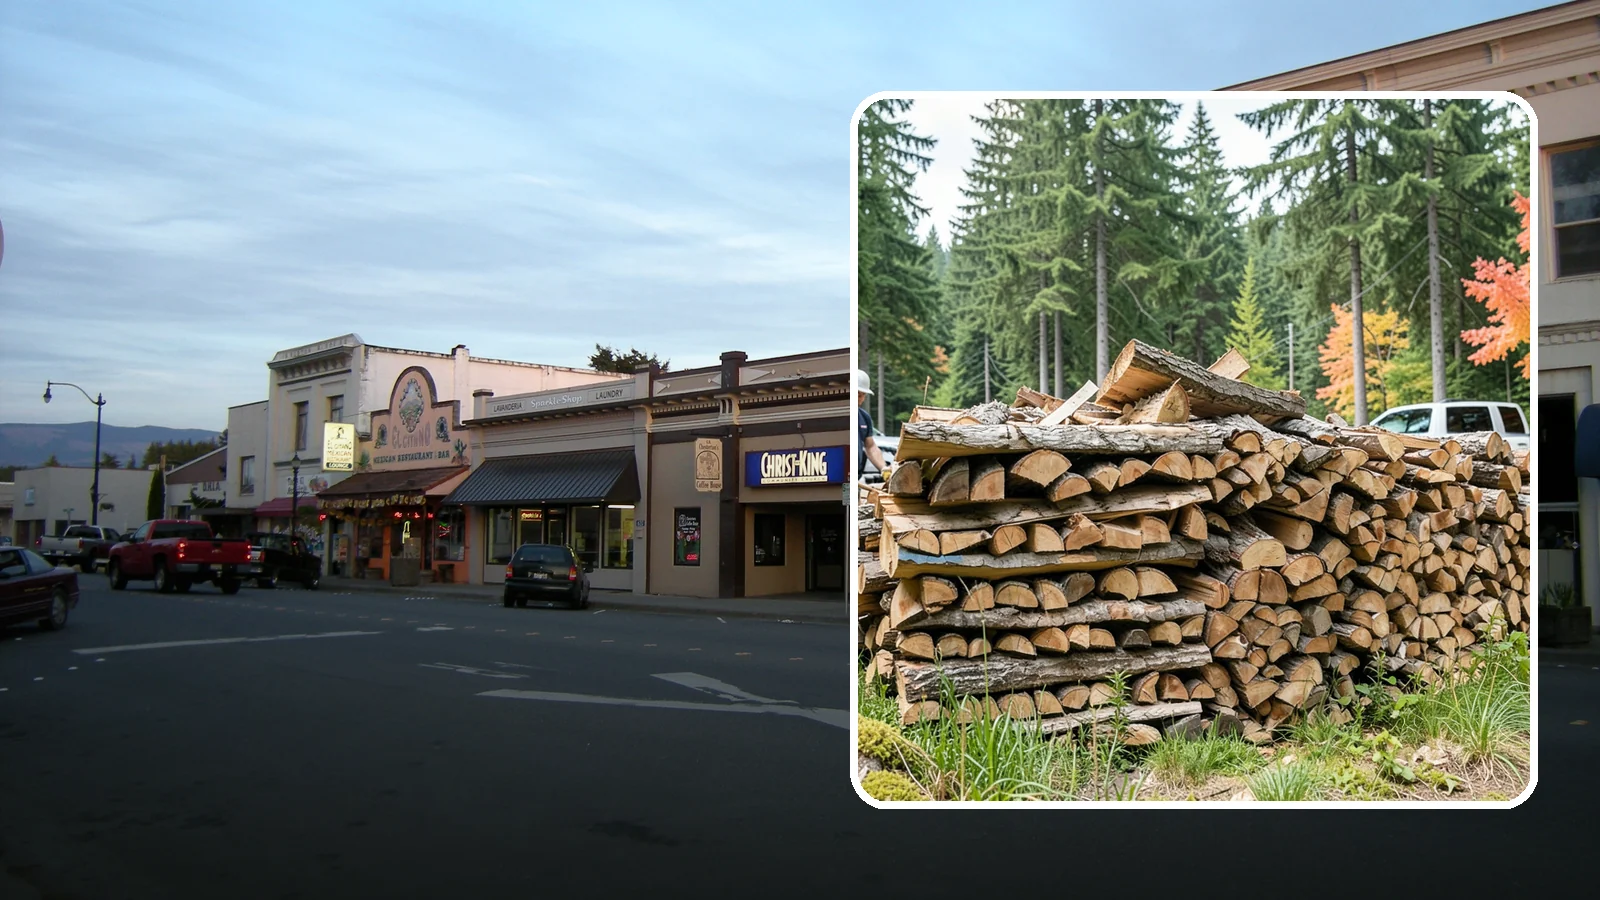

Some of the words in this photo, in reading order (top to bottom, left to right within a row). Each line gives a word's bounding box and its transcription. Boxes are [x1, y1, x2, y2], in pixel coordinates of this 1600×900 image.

[493, 402, 522, 412] LAVANDERIA
[595, 388, 623, 399] LAUNDRY
[373, 455, 396, 464] MEXICAN
[398, 451, 434, 462] RESTAURANT
[438, 450, 450, 459] BAR
[799, 450, 827, 476] KING
